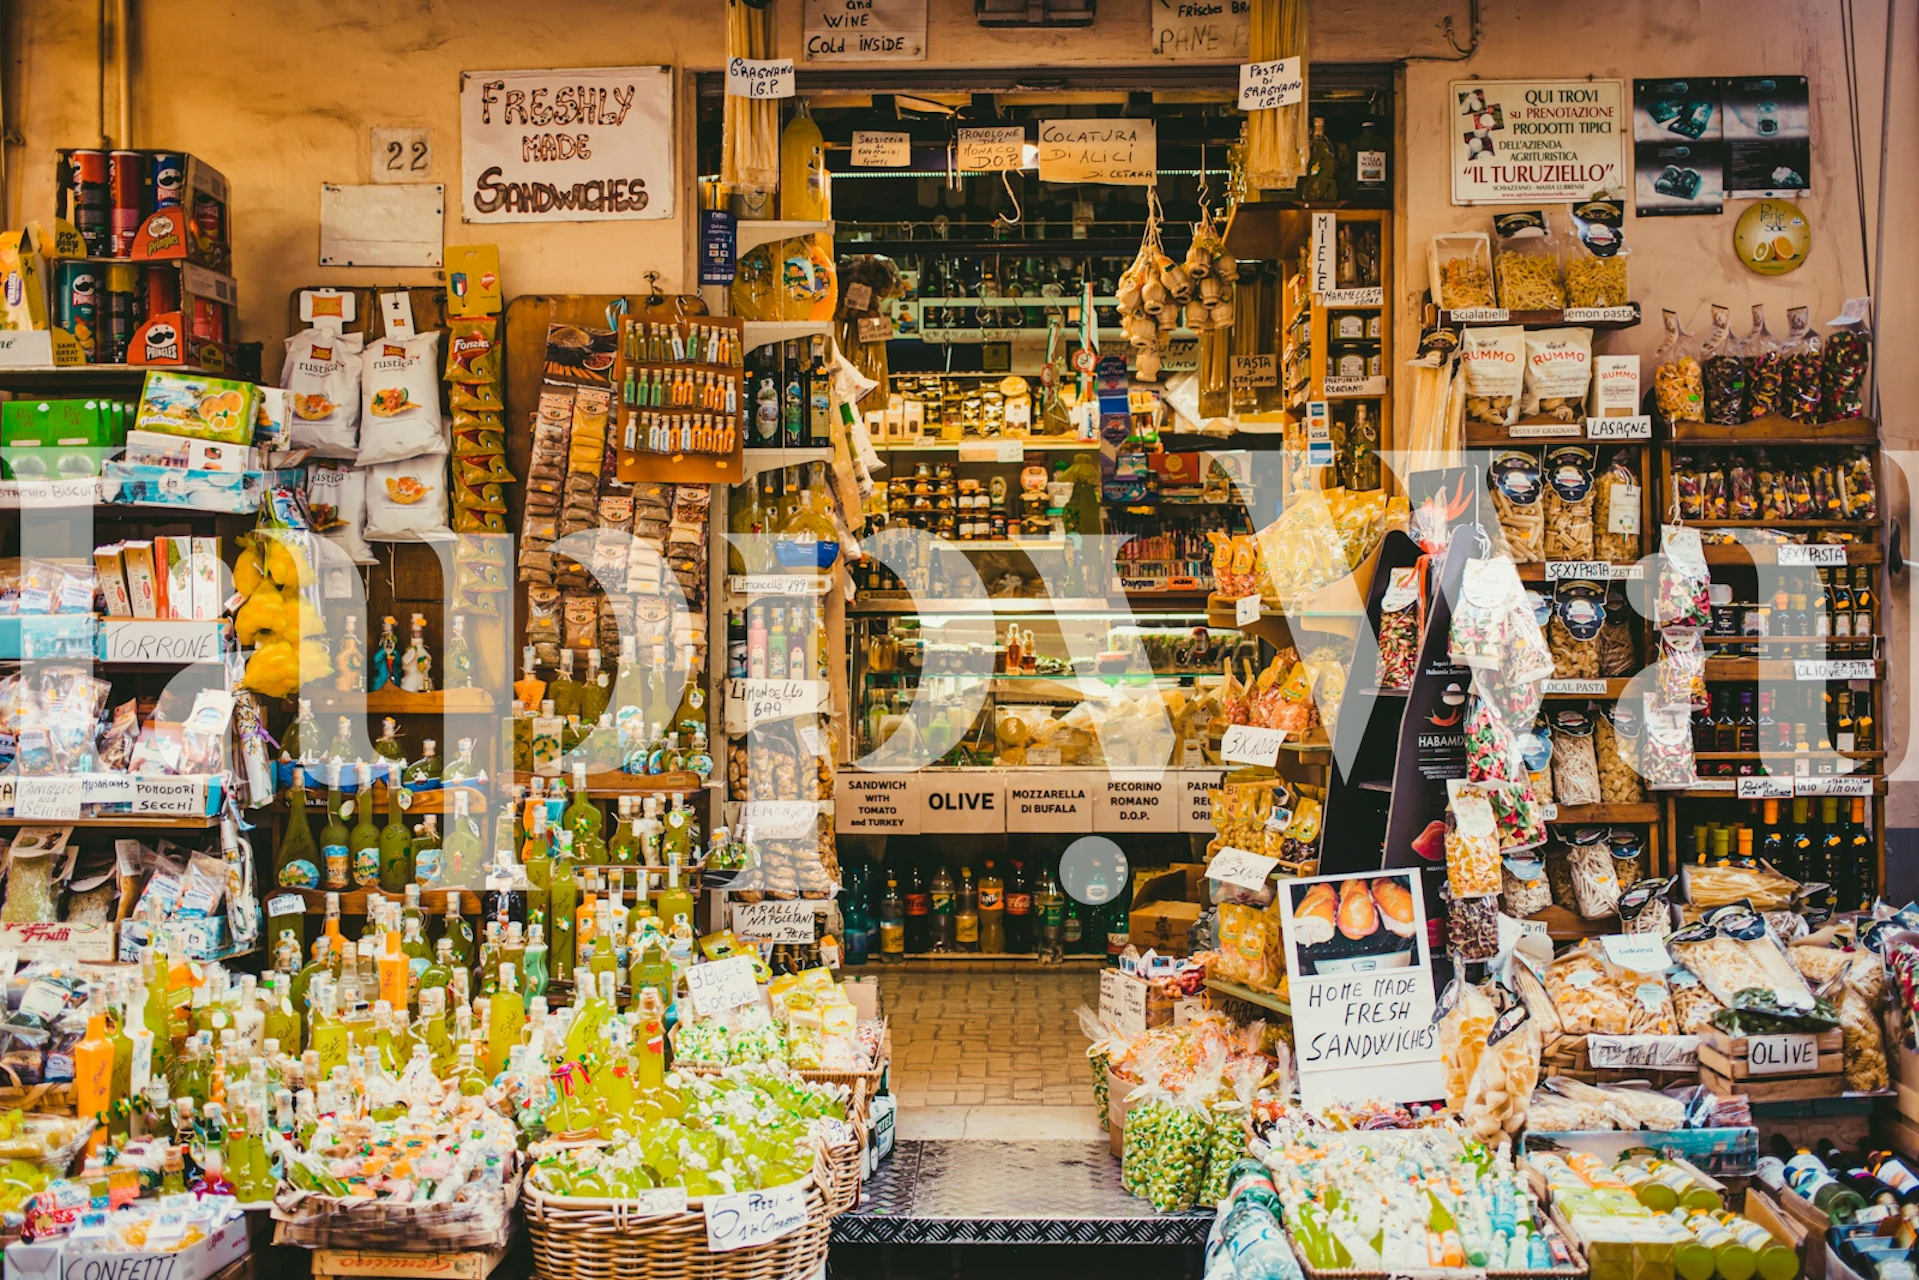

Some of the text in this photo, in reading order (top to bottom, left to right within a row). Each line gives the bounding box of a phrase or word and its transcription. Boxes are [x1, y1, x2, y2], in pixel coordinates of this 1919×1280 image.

[1160, 24, 1219, 54] PANE
[729, 57, 794, 80] GRAGNANO
[1250, 63, 1285, 77] PASTA
[1243, 81, 1301, 99] GRAGNANO
[481, 79, 635, 126] FRESHLY
[1525, 89, 1598, 106] QUI TROVI
[1526, 106, 1614, 118] PRENOTAZIONE
[1043, 125, 1137, 144] COLATURA
[1513, 121, 1612, 135] PRODOTTI TIPICI
[522, 132, 592, 163] MADE
[1499, 140, 1563, 150] DELL'AZIENDA
[386, 140, 428, 171] 22
[1510, 151, 1578, 162] AGRITURISTICA
[473, 166, 649, 214] SANDWICHES
[147, 233, 180, 257] Pringles
[1452, 309, 1508, 320] Scialatielli
[1603, 310, 1633, 321] pasta
[57, 342, 77, 350] SAME
[146, 343, 178, 361] PRINGLES
[454, 338, 490, 352] Fonzies
[373, 357, 414, 370] rustica
[1237, 357, 1272, 369] PASTA
[1462, 350, 1516, 363] RUMMO
[1533, 351, 1586, 367] RUMMO
[299, 360, 338, 374] rustica
[1601, 371, 1637, 381] RUMMO
[1591, 420, 1648, 437] LASAGNE
[1809, 545, 1844, 563] PASTA
[1548, 563, 1610, 578] SEXY PASTA
[1121, 578, 1155, 589] Daygum
[108, 622, 213, 660] TORRONE
[136, 783, 195, 795] POMODORI
[848, 780, 907, 790] SANDWICH
[1107, 782, 1162, 792] PECORINO
[865, 794, 890, 803] WITH
[1012, 789, 1086, 799] MOZZARELLA
[138, 797, 193, 811] SECCHI
[928, 792, 995, 811] OLIVE
[1110, 797, 1159, 806] ROMANO
[858, 806, 897, 815] TOMATO
[1021, 804, 1077, 814] DI BUFALA
[1119, 811, 1150, 821] D.O.P.
[850, 818, 905, 827] and TURKEY
[738, 902, 800, 917] TARALLI
[1309, 977, 1417, 1008] HOME MADE
[1344, 1001, 1411, 1026] FRESH
[1306, 1024, 1436, 1062] SANDWICHES
[1751, 1038, 1814, 1066] OLIVE
[66, 1253, 178, 1280] CONFETTI
